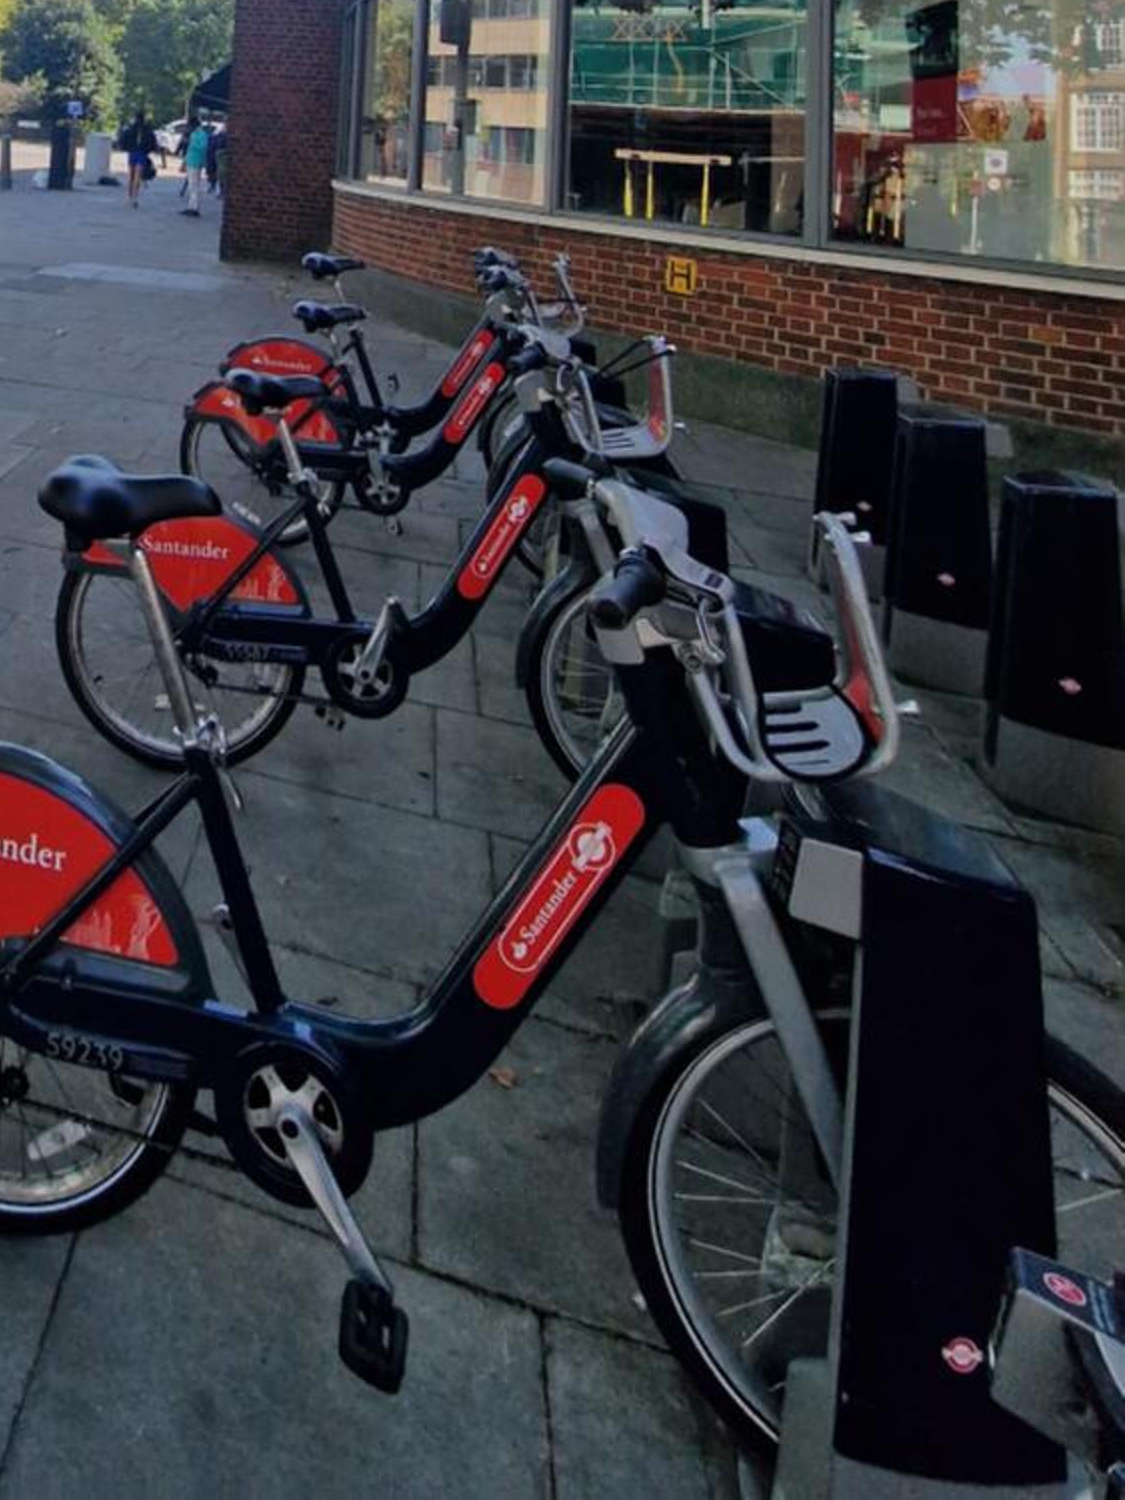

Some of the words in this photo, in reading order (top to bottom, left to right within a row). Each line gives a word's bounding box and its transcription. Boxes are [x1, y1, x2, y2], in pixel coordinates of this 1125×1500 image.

[670, 259, 691, 291] H
[140, 534, 228, 560] Santander
[520, 870, 576, 946] Santander
